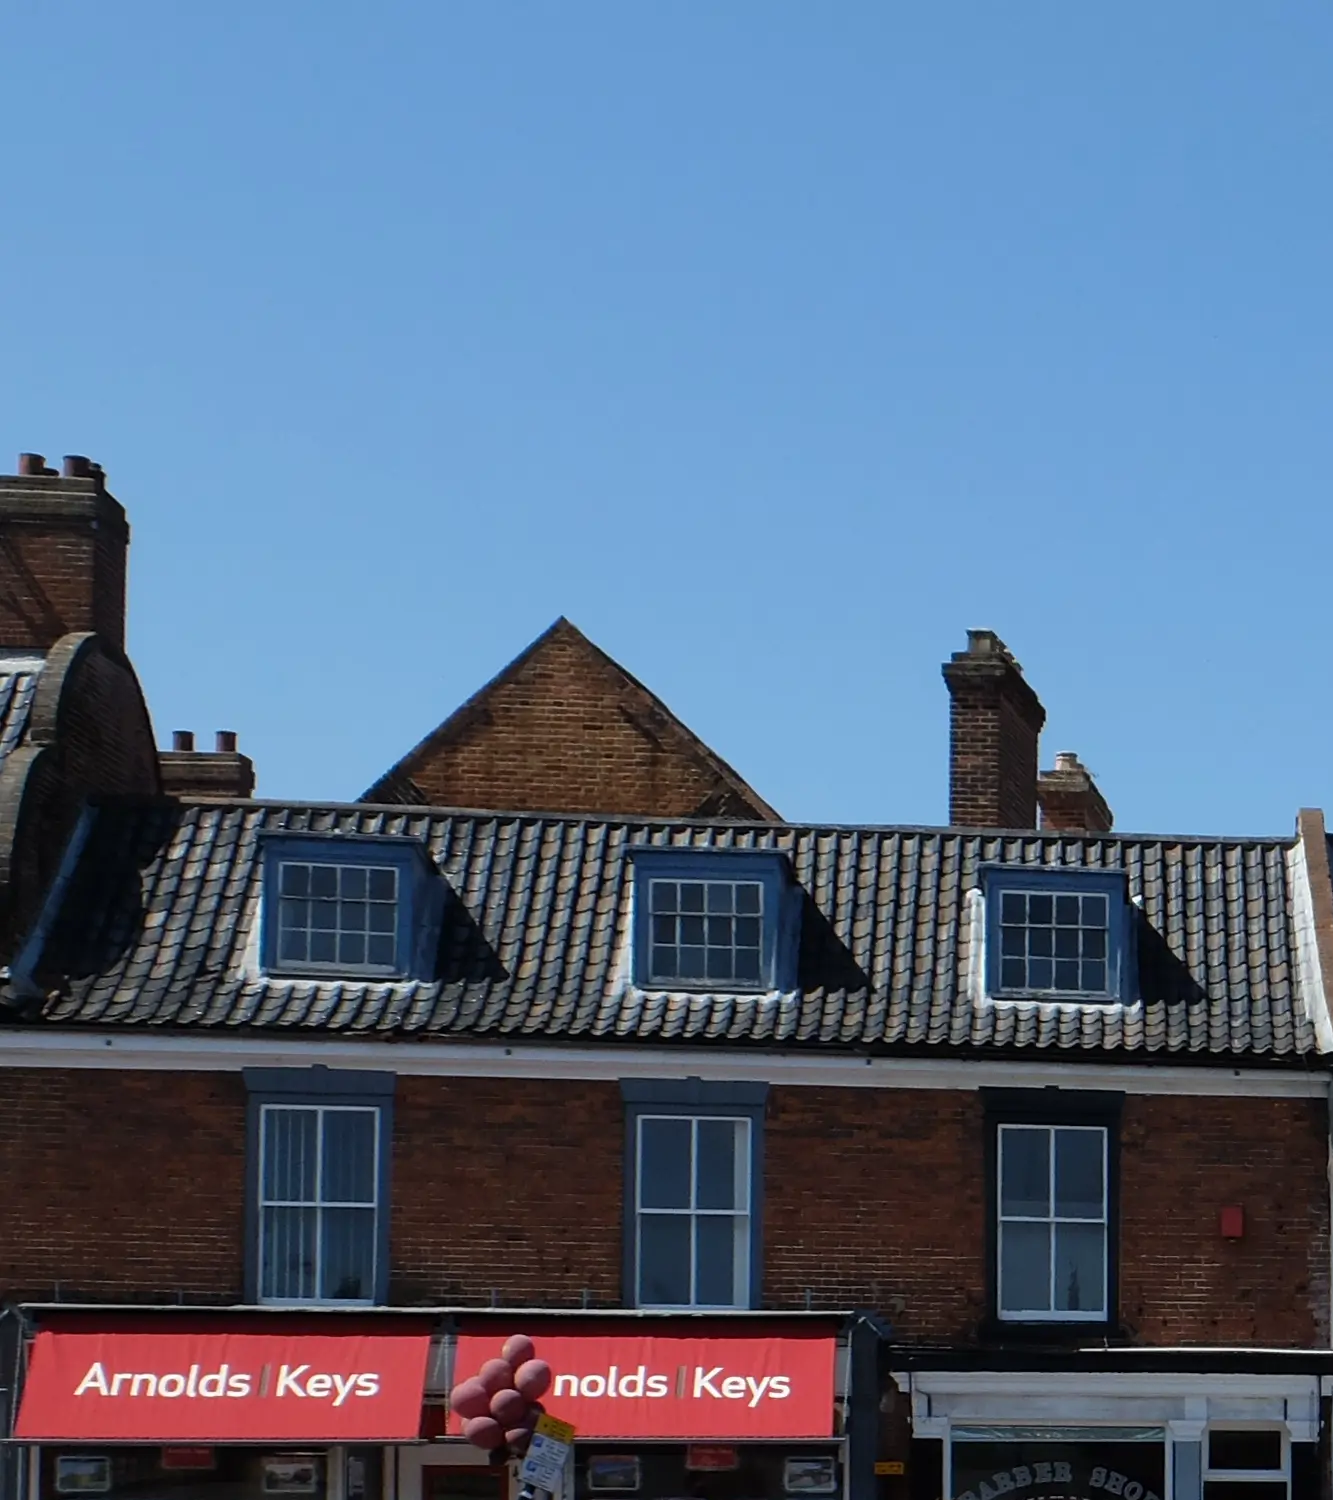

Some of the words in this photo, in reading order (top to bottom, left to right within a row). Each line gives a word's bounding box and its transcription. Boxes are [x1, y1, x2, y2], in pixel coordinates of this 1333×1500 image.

[73, 1362, 251, 1398] Arnolds
[276, 1364, 379, 1406] Keys
[553, 1365, 668, 1398] nolds
[693, 1366, 791, 1408] Keys
